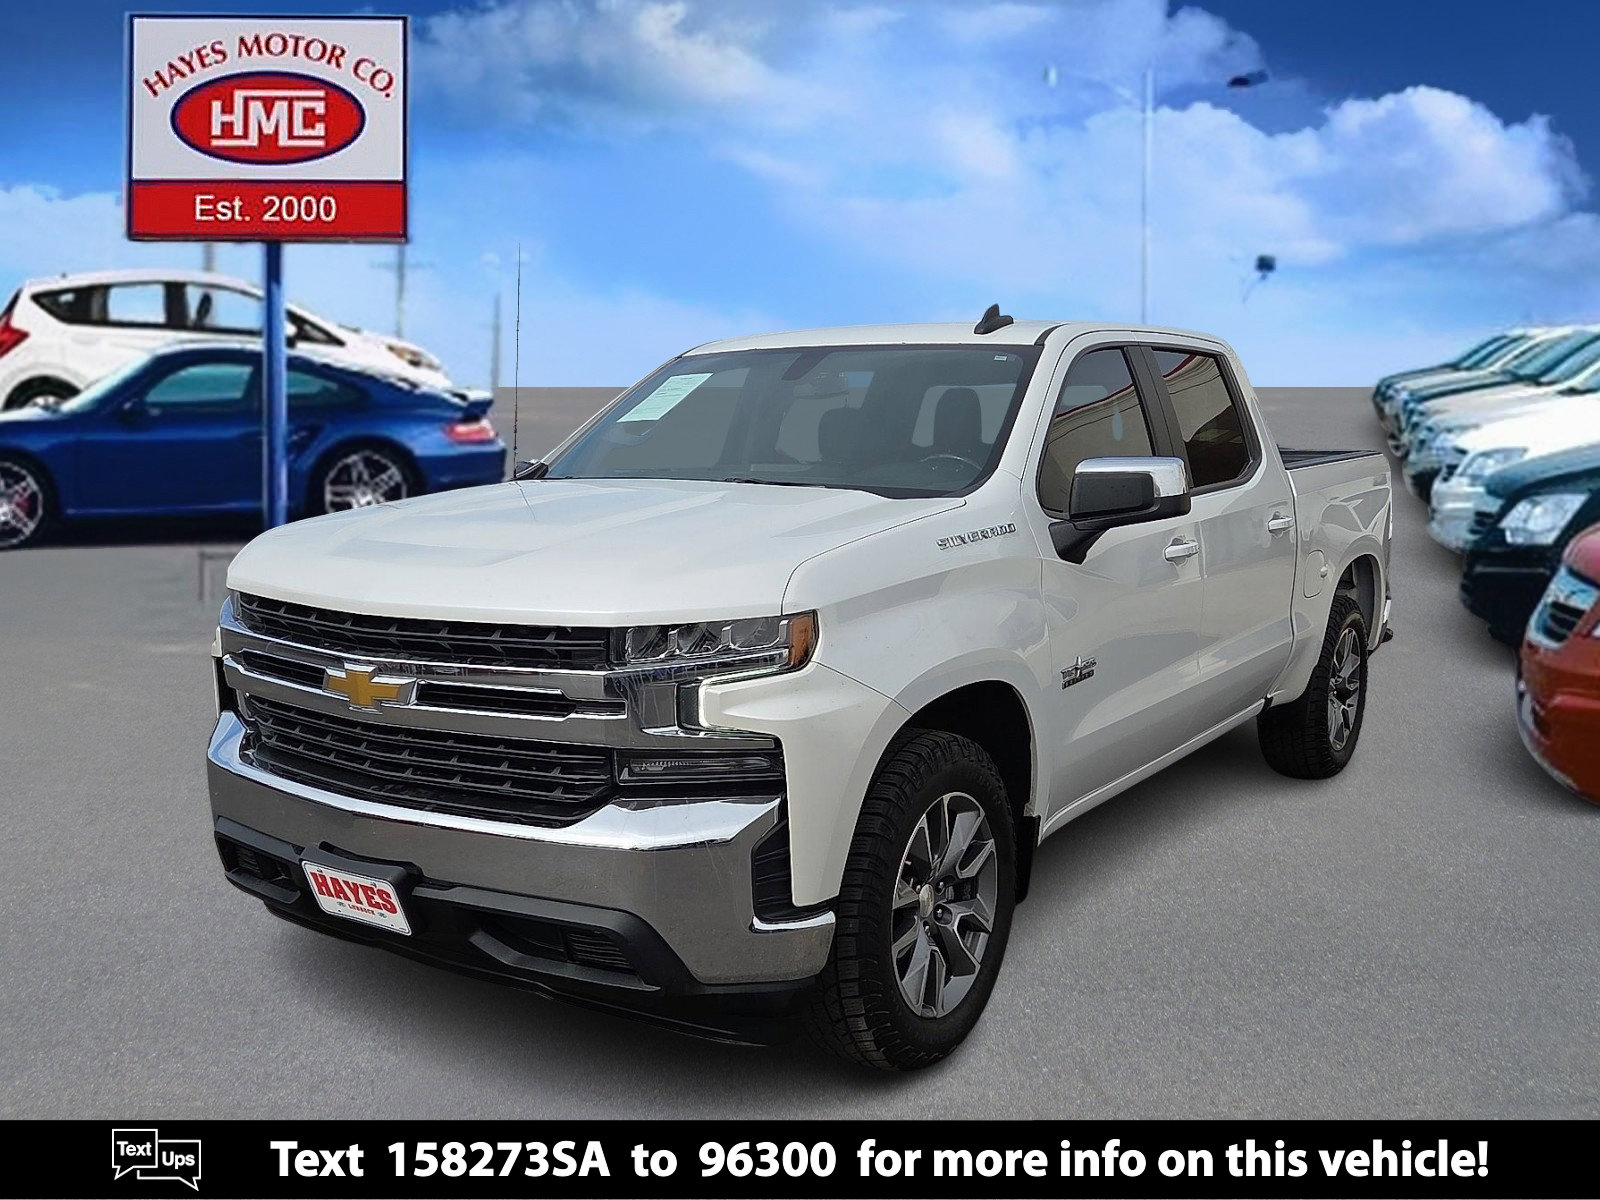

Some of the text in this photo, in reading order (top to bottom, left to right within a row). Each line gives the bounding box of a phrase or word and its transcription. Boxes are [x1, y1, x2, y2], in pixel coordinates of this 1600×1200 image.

[142, 32, 394, 98] HAYES MOTOR CO.
[210, 88, 326, 148] HMC
[194, 194, 337, 222] Est. 2000
[936, 522, 1017, 551] SILVERADO
[310, 871, 398, 915] HAYES
